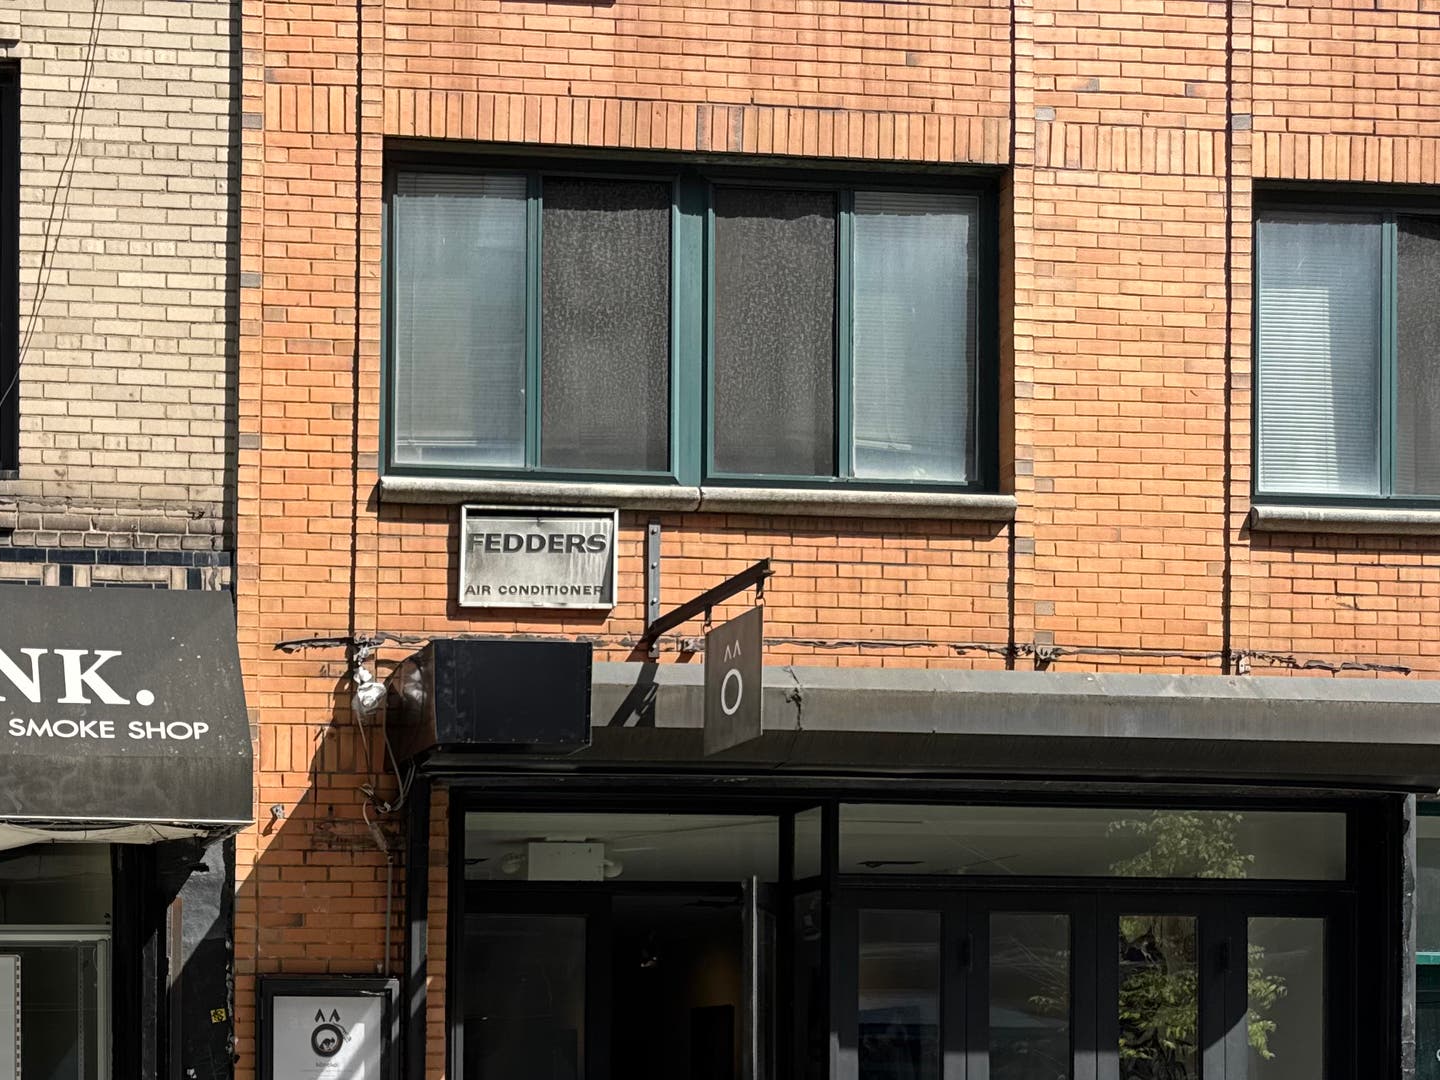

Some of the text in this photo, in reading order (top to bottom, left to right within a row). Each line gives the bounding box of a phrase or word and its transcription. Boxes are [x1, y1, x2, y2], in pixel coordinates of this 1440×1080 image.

[469, 532, 608, 554] FEDDERS
[465, 584, 605, 597] AIR CONDITIONER
[8, 718, 210, 740] SMOKE SHOP
